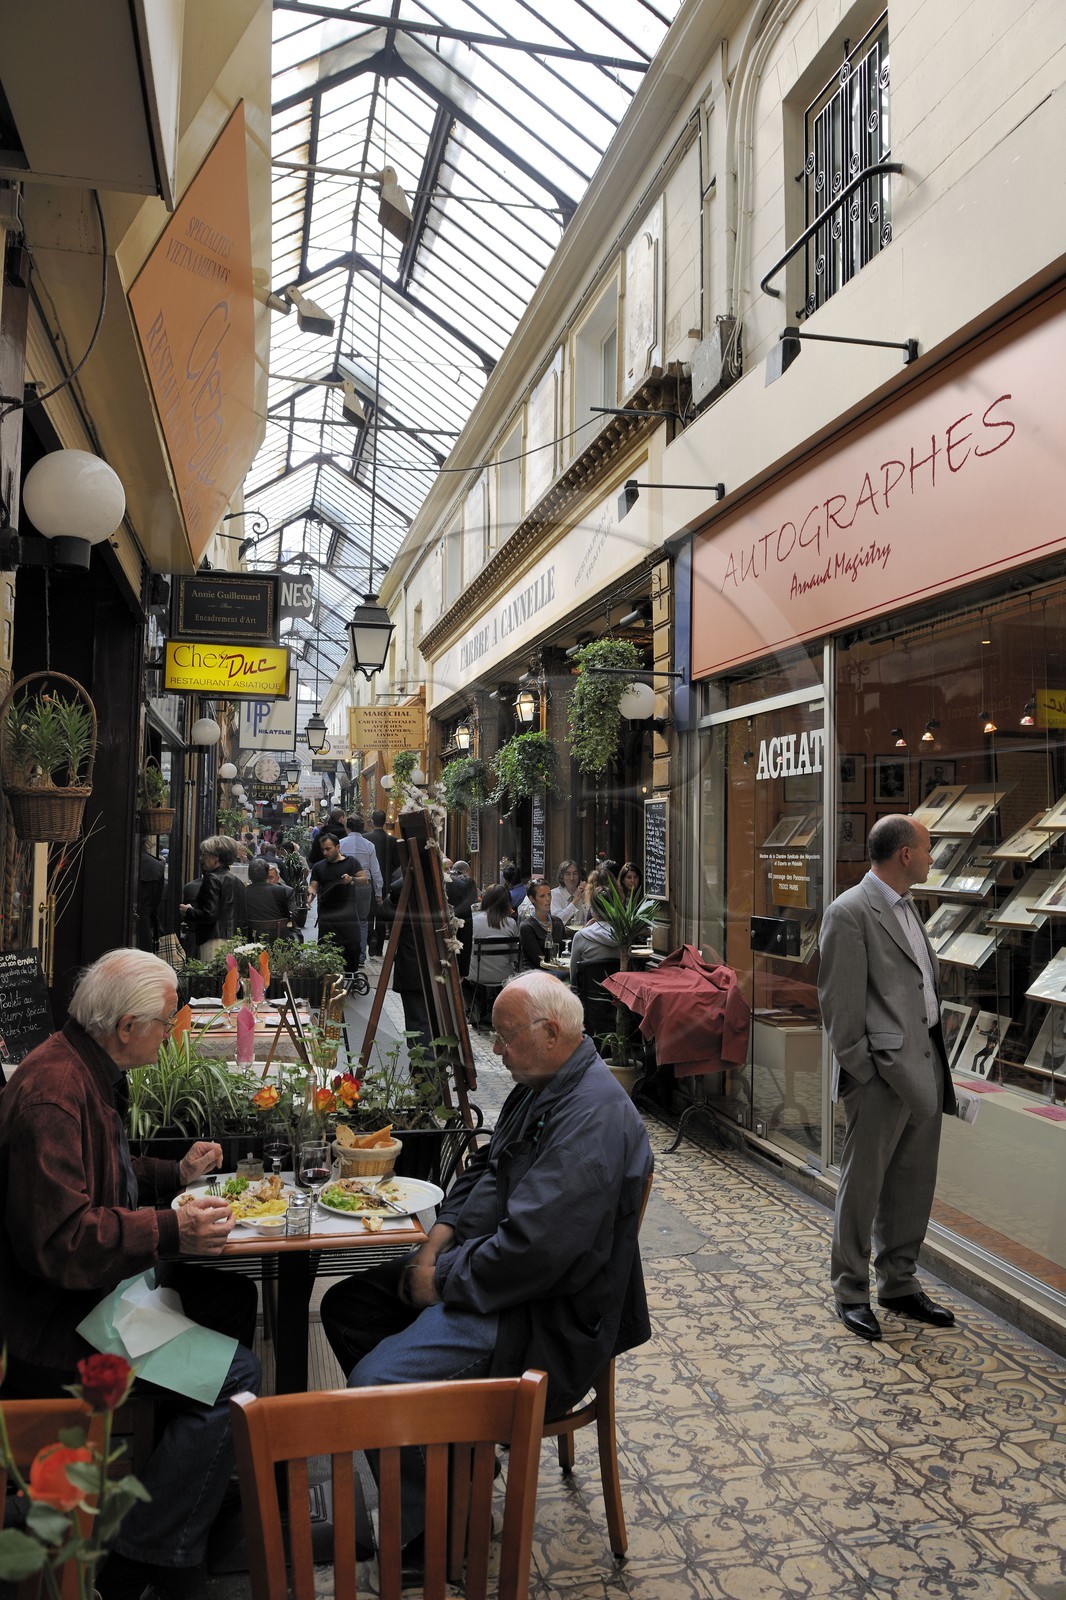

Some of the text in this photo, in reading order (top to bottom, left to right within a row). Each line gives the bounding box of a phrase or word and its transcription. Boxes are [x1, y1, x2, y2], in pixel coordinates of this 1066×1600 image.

[720, 394, 1016, 594] AUTOGRAPHES
[790, 540, 892, 599] Arnaud Magistry
[192, 589, 261, 601] Annie Guillemard
[195, 613, 256, 624] Encadrement d'Art
[460, 624, 490, 672] L'ARBRE
[491, 618, 498, 648] A
[501, 565, 556, 639] CANNELLE
[173, 643, 277, 679] Chez Duc
[170, 677, 281, 691] RESTAURANT ASIATIQUE
[756, 727, 825, 781] ACHAT
